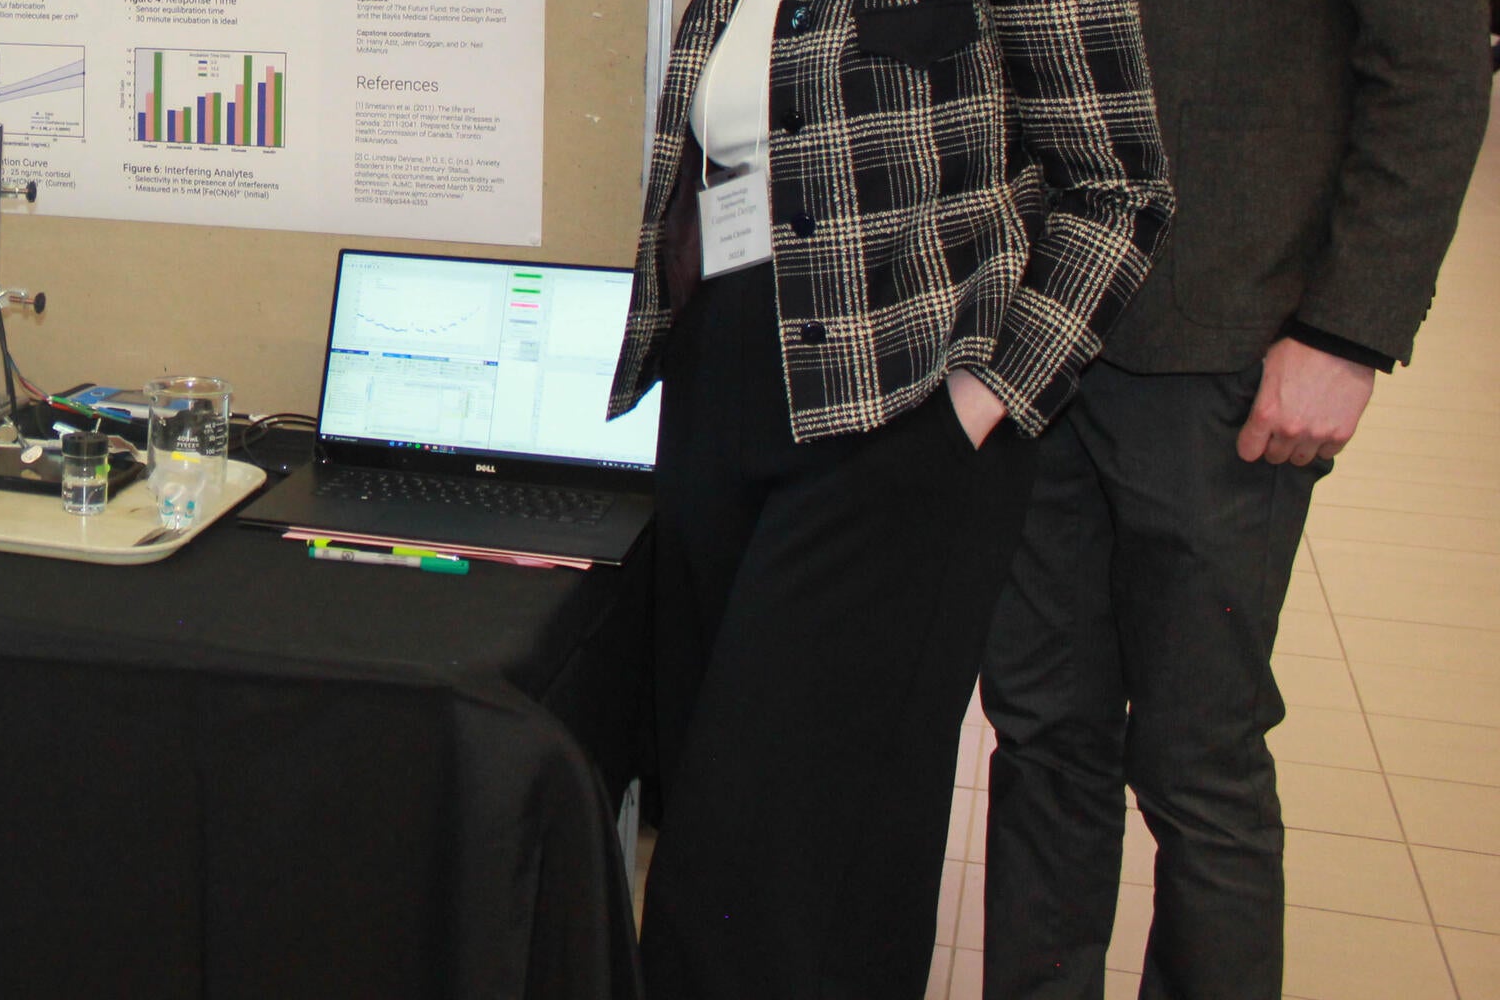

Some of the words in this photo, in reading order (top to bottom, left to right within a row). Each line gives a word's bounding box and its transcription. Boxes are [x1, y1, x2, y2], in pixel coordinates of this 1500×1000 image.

[136, 6, 160, 14] Sensor
[162, 6, 207, 14] equilibration
[357, 76, 439, 92] References
[123, 163, 152, 174] Figure
[164, 166, 212, 179] Interfering
[214, 169, 254, 181] Analytes
[476, 464, 496, 472] DELL
